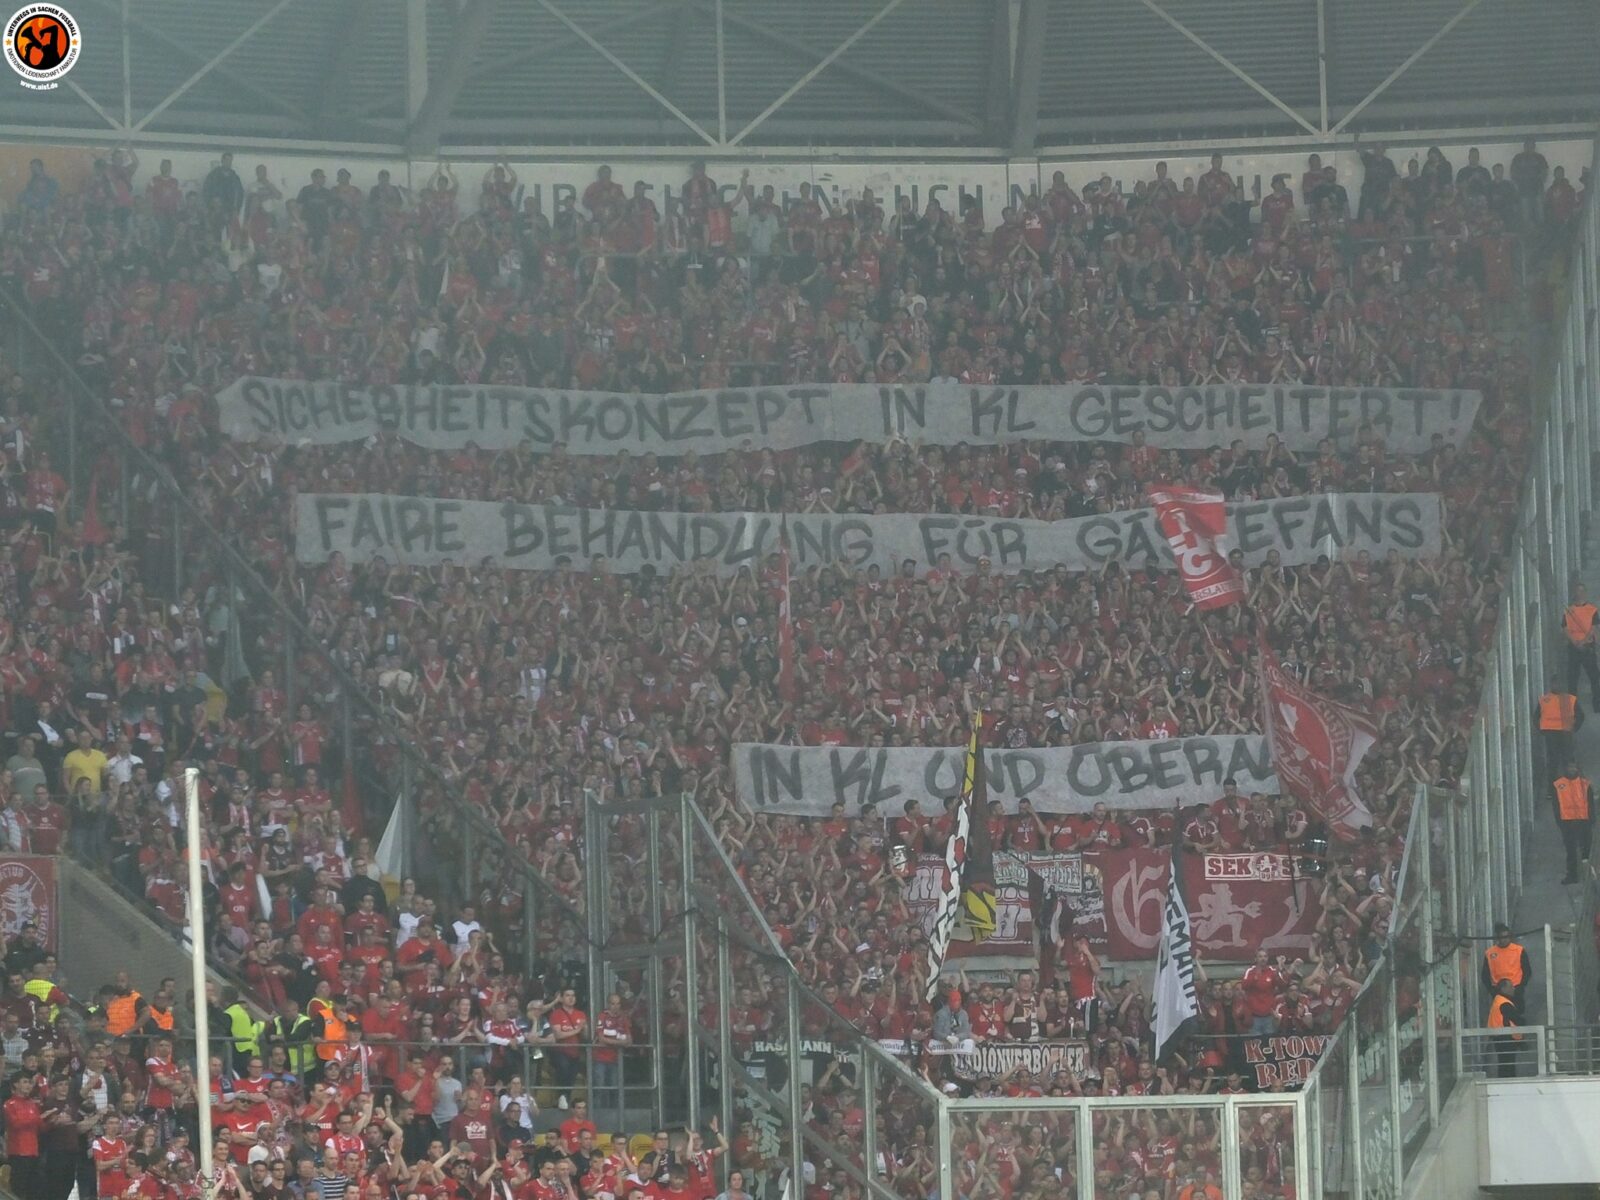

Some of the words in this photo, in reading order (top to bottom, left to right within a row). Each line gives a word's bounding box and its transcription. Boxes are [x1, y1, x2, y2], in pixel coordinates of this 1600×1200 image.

[240, 378, 829, 443] SICHERHEITSKONZEPT
[880, 388, 926, 432] IN
[970, 389, 1037, 436] KL
[316, 499, 467, 553] FAIRE
[502, 507, 873, 566] BEHANDLUNG
[1076, 498, 1425, 563] GÄEFANS
[750, 746, 804, 805] IN
[830, 748, 902, 804] KL
[1208, 857, 1252, 876] SEK
[1244, 1034, 1336, 1063] K-TOW
